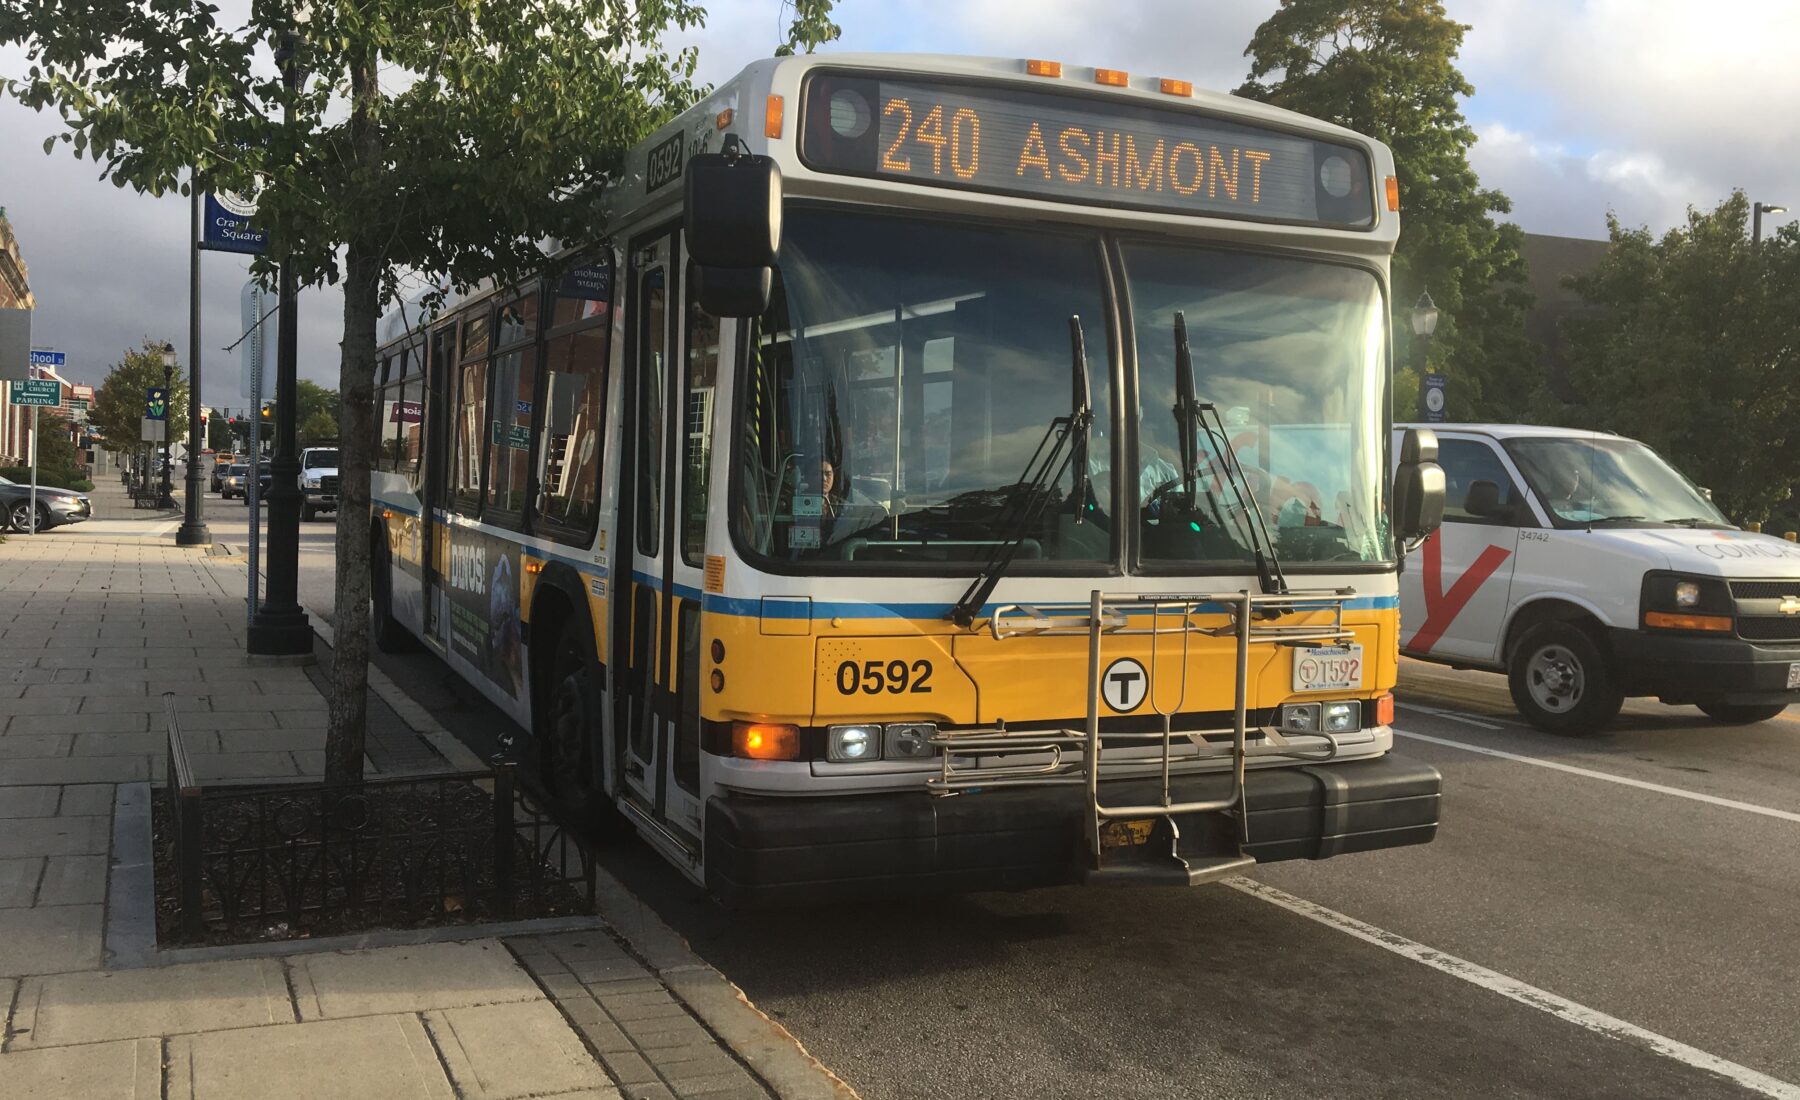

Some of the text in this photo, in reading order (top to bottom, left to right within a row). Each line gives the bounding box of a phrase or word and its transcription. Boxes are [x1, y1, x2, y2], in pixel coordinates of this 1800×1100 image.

[650, 138, 680, 187] 0592
[881, 97, 1271, 202] 240 ASHMONT
[221, 228, 262, 242] Square
[16, 397, 54, 405] PARKING
[1520, 531, 1550, 543] 34742
[451, 544, 486, 595] DINOS!
[836, 659, 933, 695] 0592
[1320, 659, 1359, 682] T592
